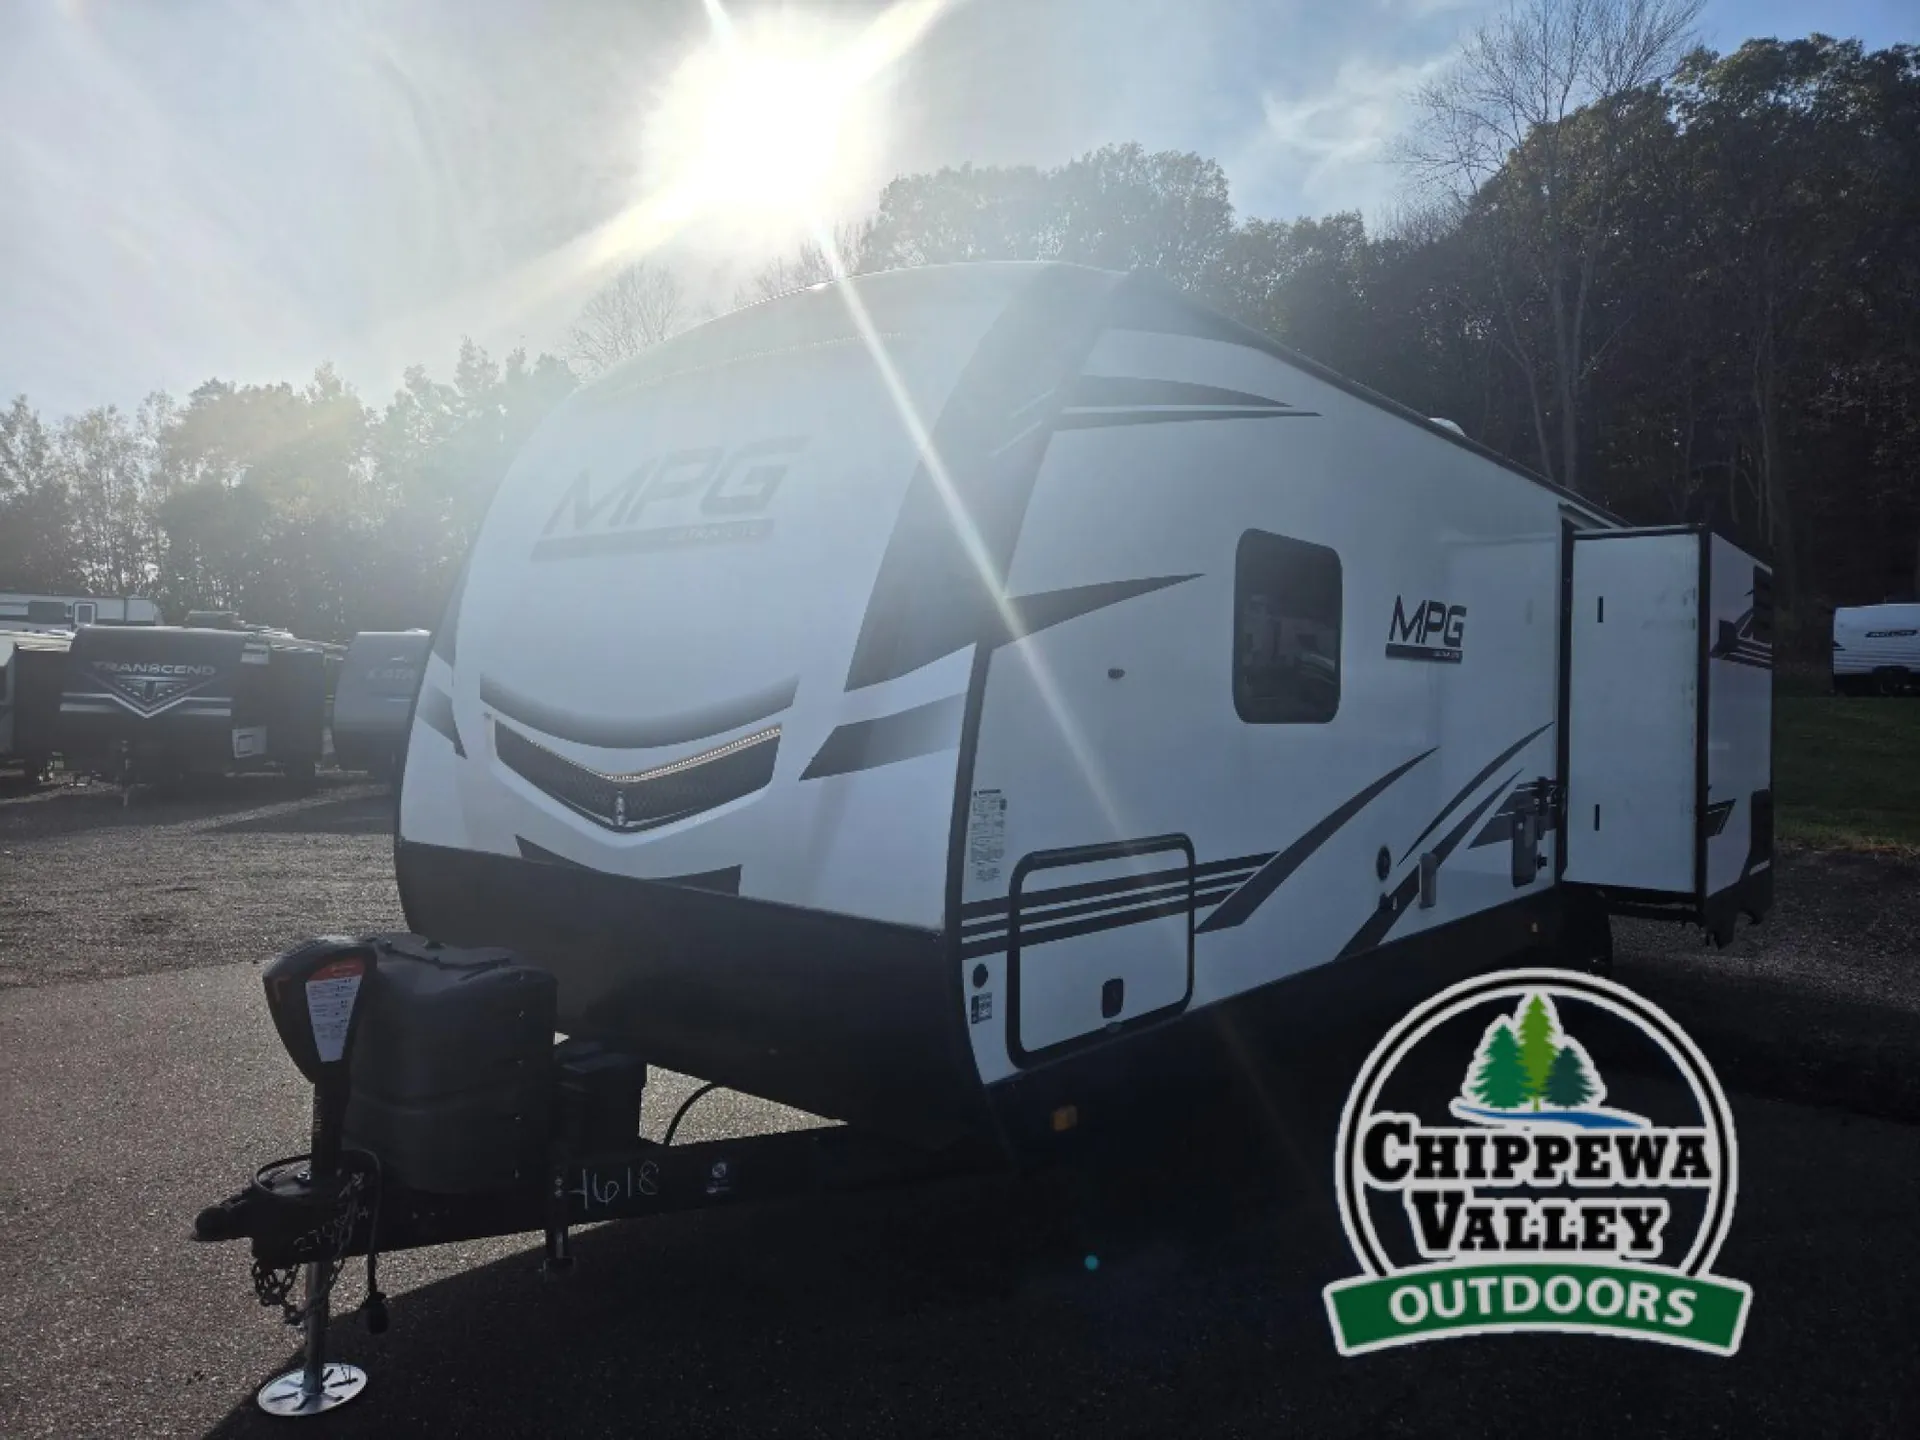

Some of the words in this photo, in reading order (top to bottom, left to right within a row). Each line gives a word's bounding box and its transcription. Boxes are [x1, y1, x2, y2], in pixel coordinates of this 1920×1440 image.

[544, 435, 812, 534] MPG
[1389, 594, 1467, 647] MPG
[91, 661, 217, 676] TRANSCEND
